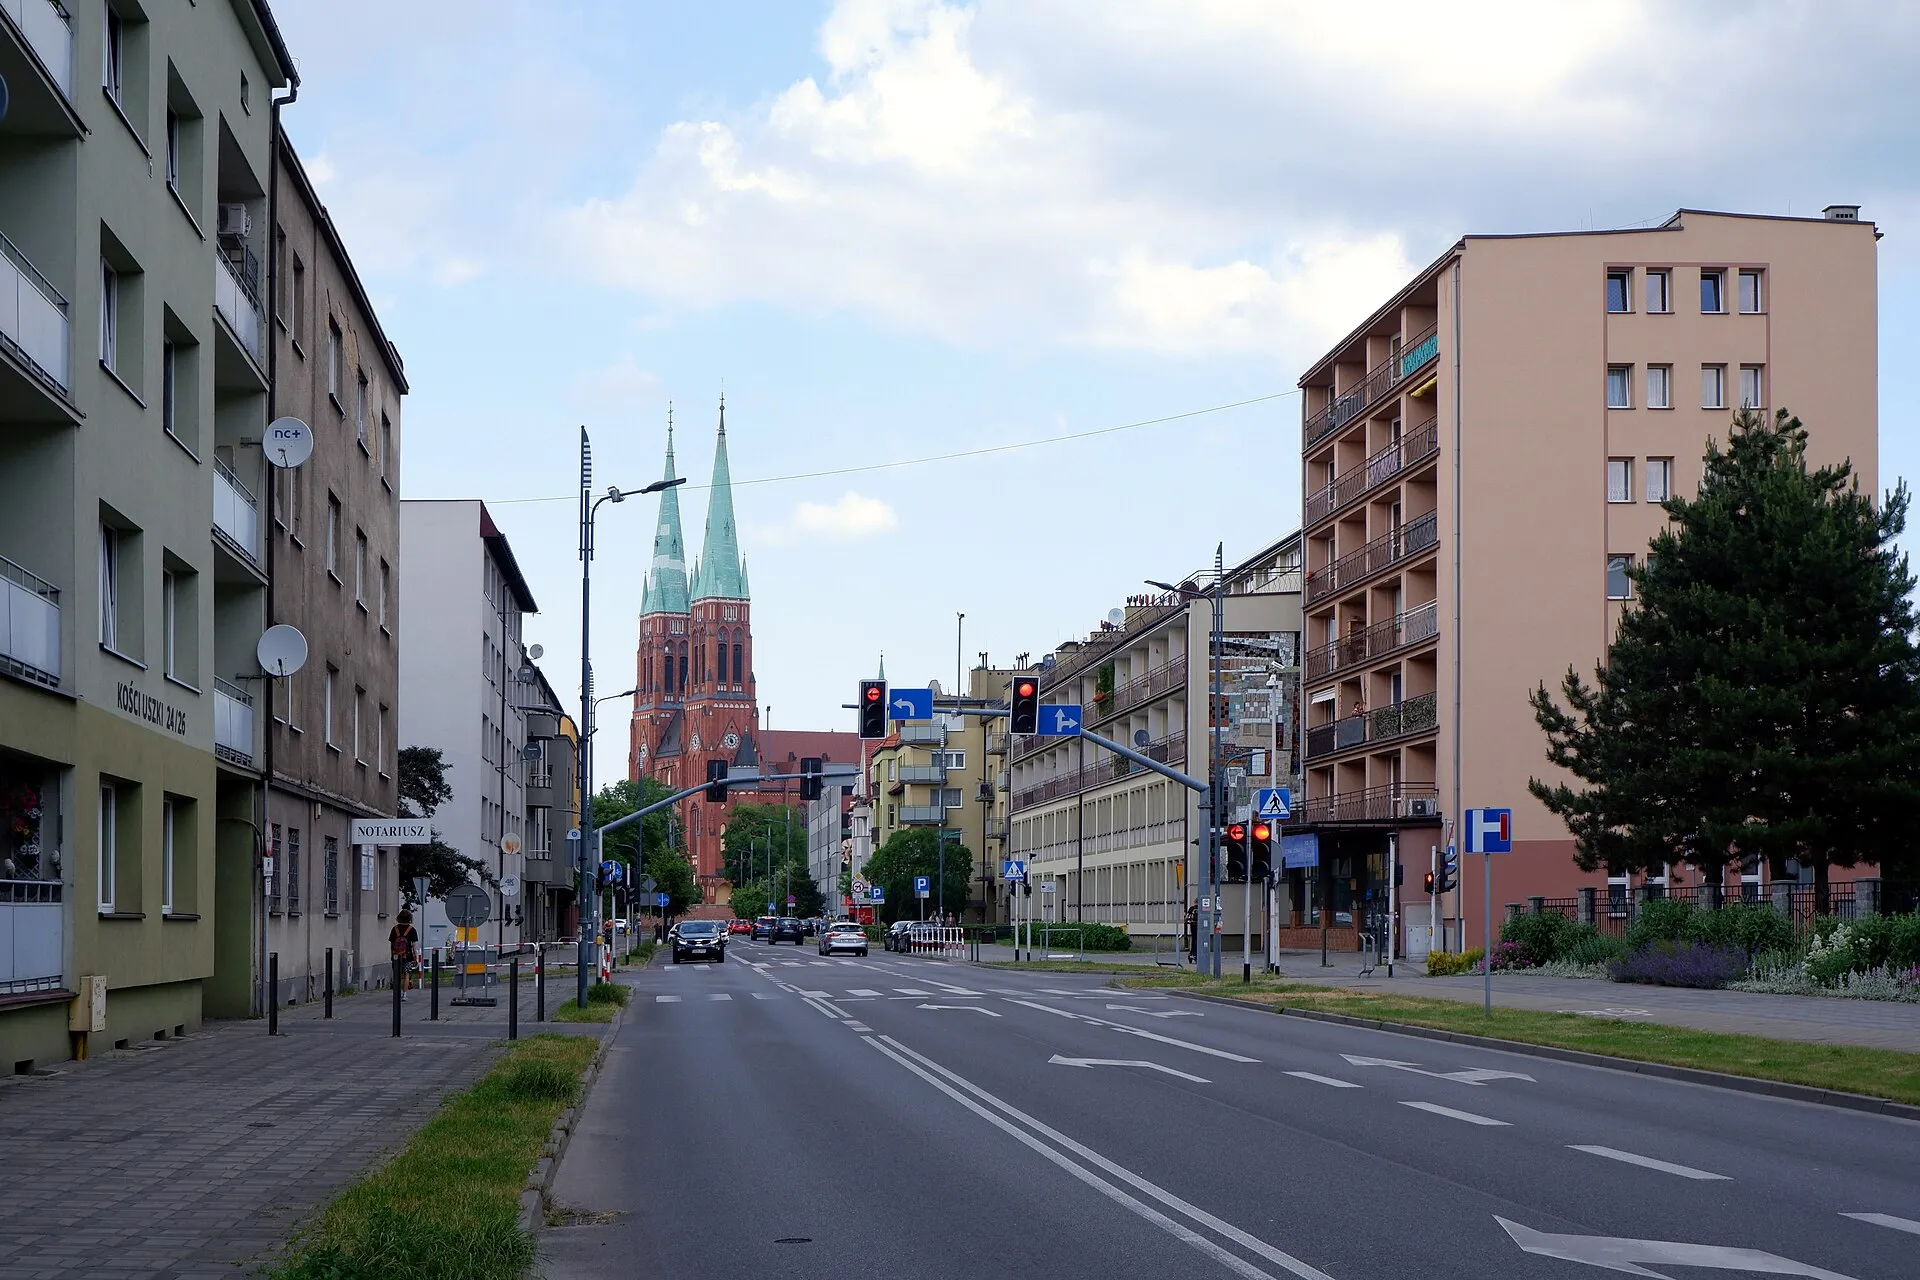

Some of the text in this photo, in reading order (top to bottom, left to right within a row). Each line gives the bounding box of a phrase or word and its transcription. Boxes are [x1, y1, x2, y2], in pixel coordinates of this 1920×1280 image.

[274, 429, 301, 439] nc+
[166, 705, 186, 736] 24/26
[357, 825, 425, 837] NOTARIUSZ
[917, 878, 927, 890] P
[873, 888, 881, 898] P
